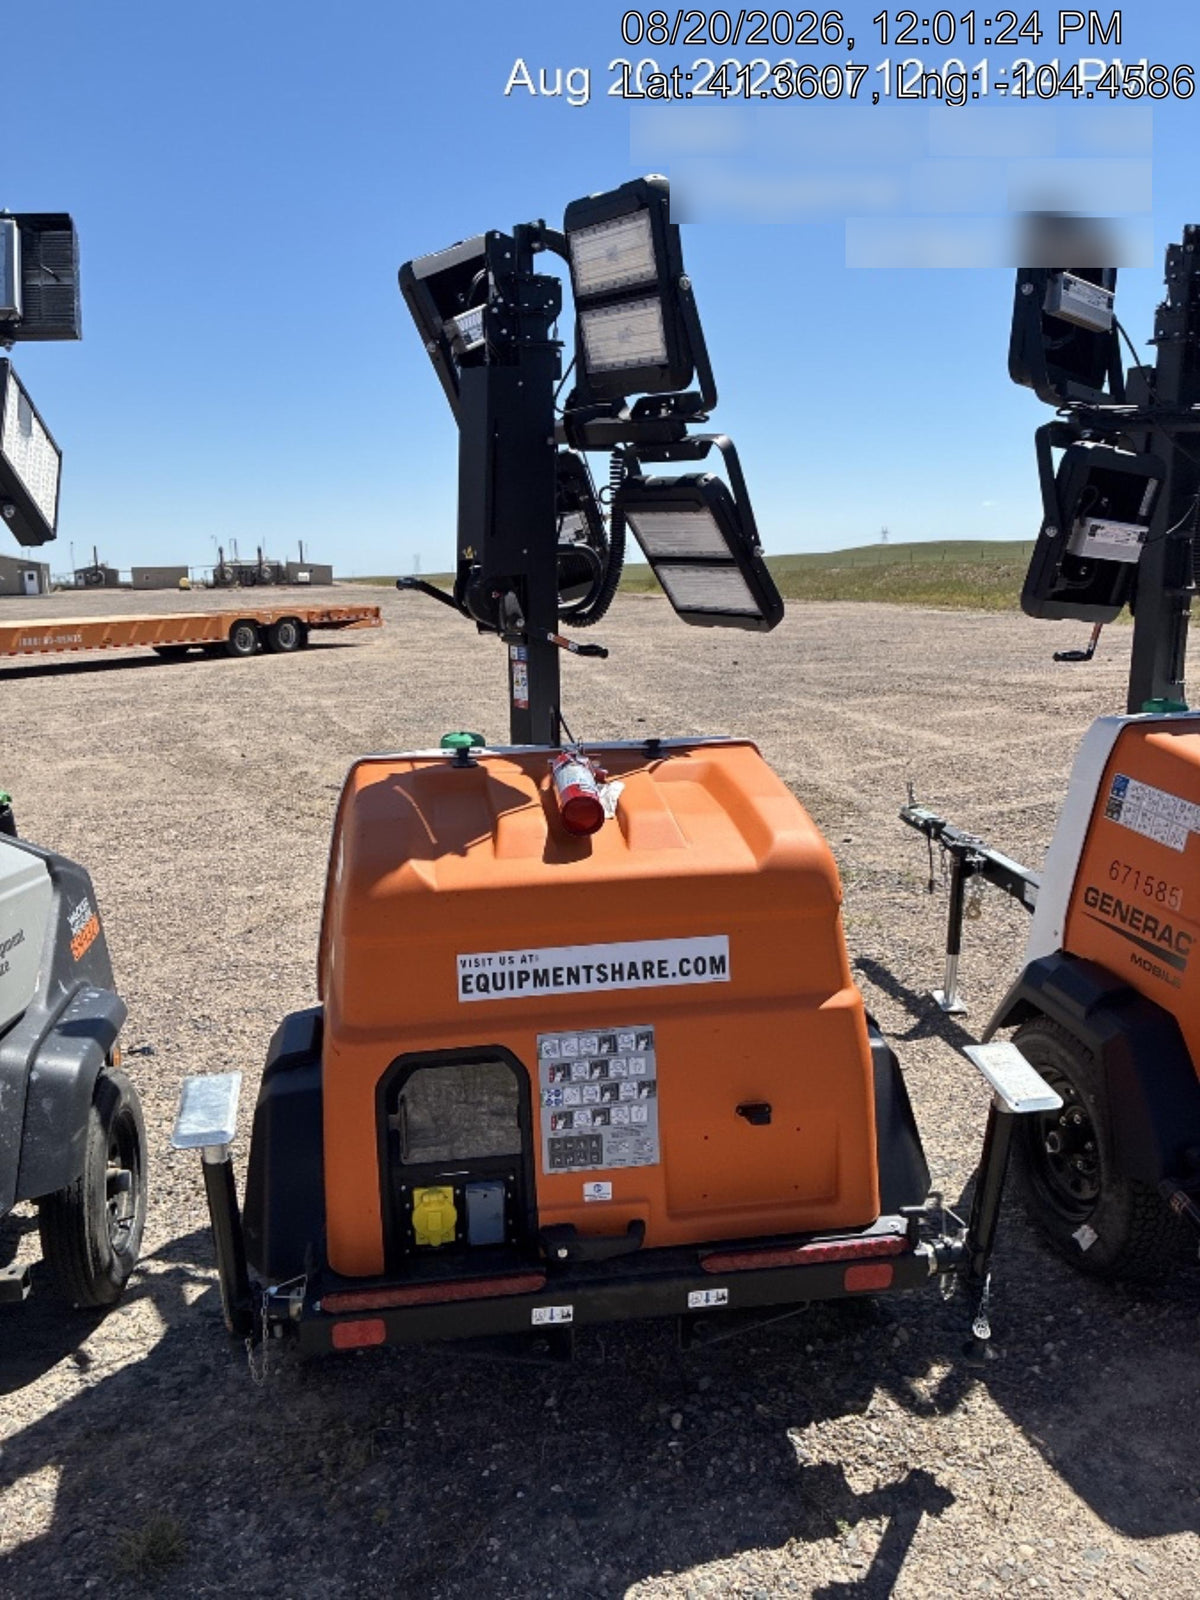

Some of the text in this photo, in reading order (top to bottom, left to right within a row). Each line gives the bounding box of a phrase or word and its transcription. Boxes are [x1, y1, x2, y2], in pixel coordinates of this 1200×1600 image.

[1083, 886, 1193, 956] GENERAC
[460, 957, 493, 968] VISIT
[499, 956, 515, 966] US
[461, 954, 727, 995] EQUIPMENTSHARE.COM
